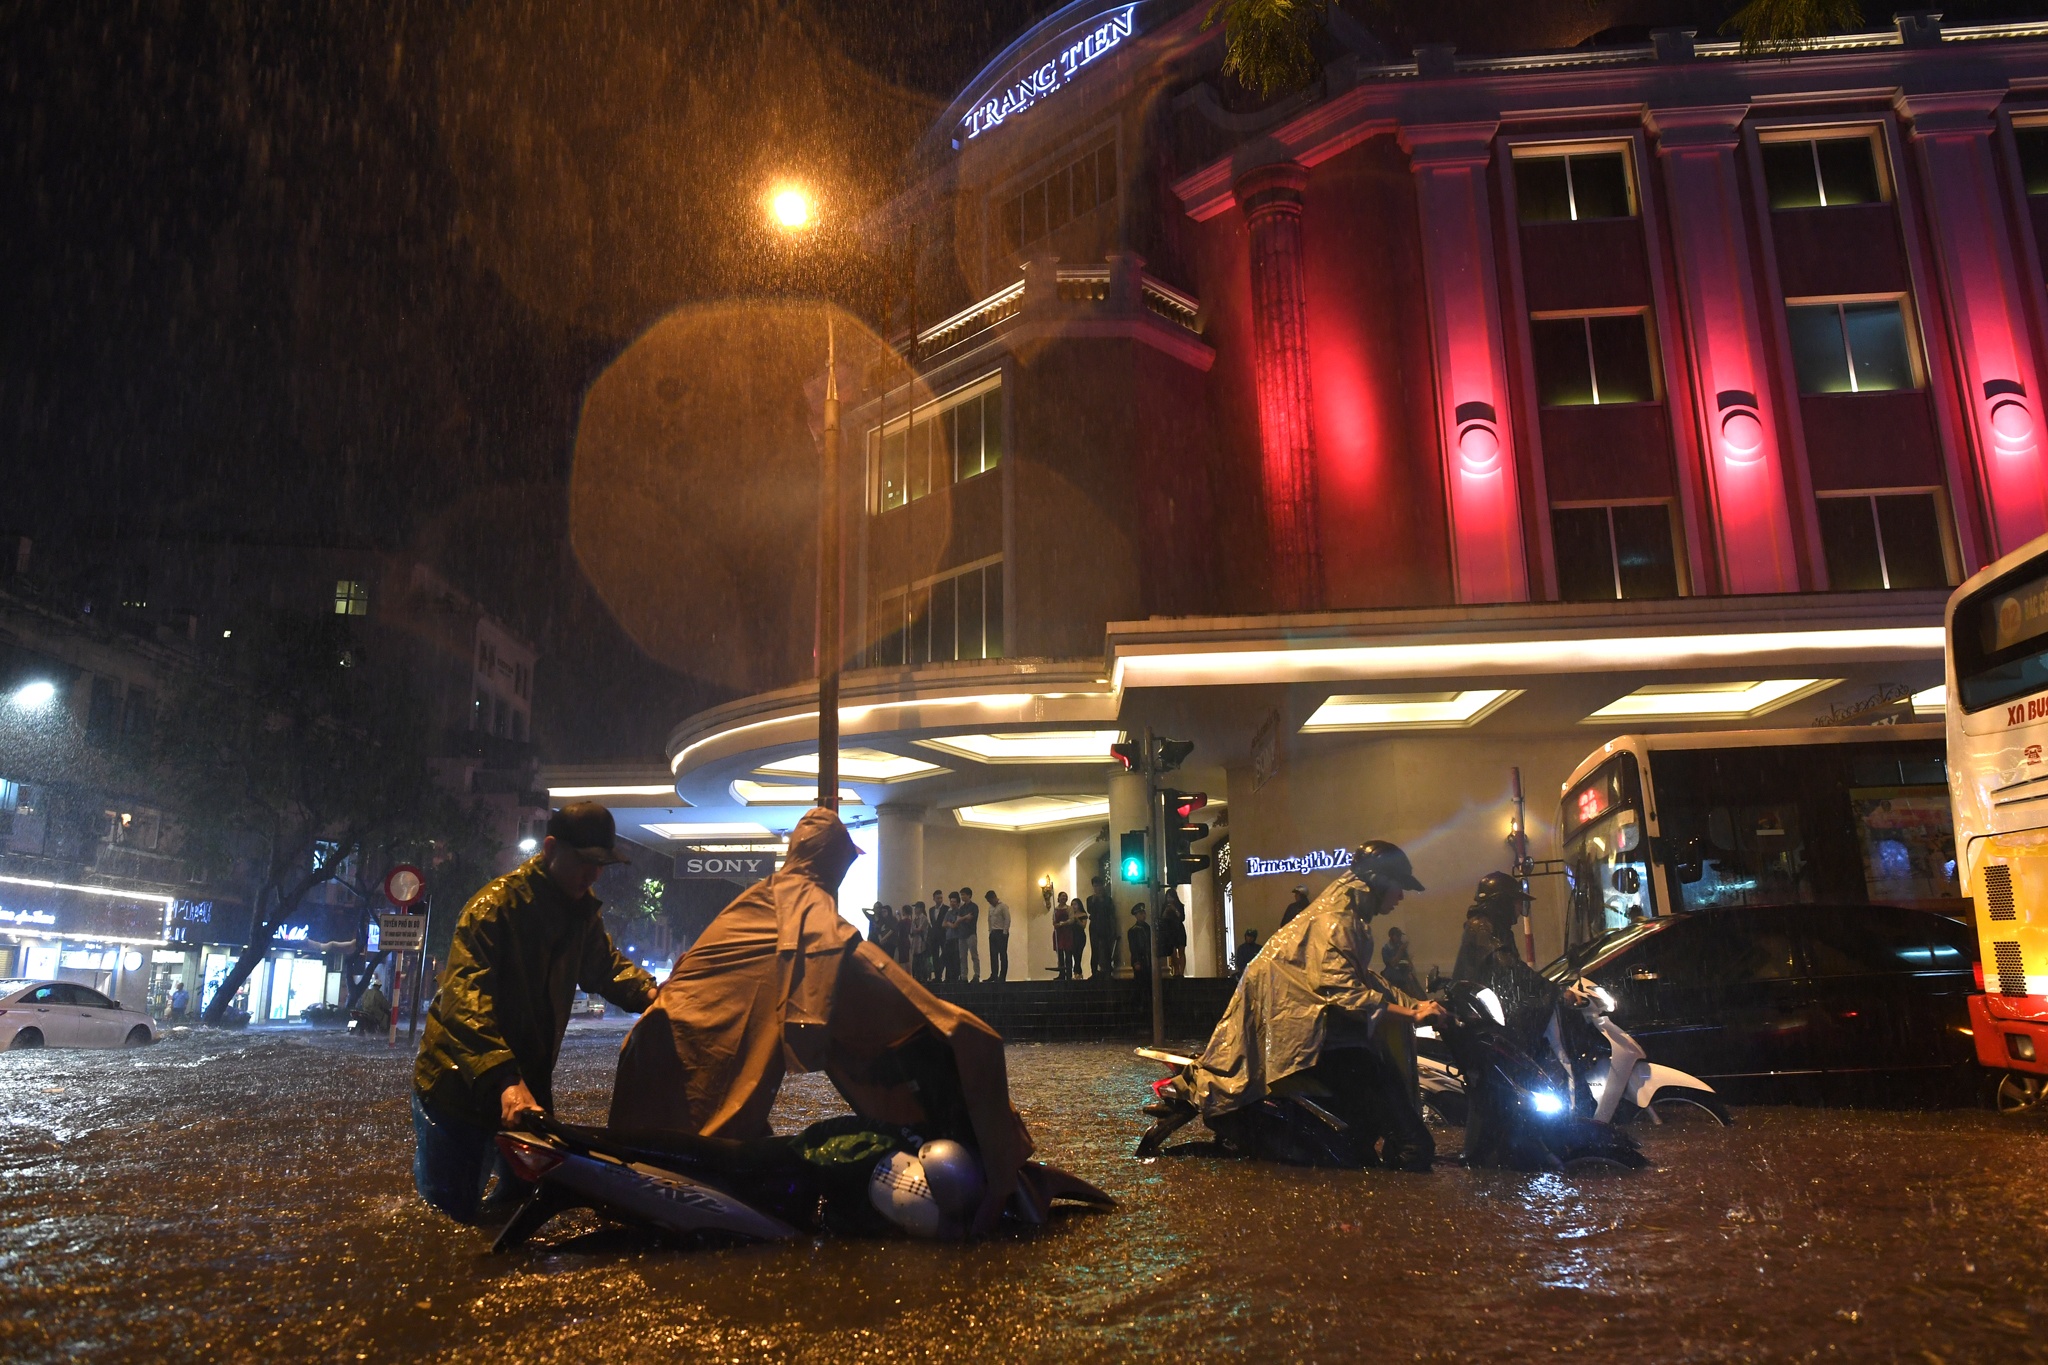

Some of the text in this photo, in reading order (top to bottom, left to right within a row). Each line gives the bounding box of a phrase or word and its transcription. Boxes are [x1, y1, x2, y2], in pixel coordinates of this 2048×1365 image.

[964, 6, 1135, 139] TRANG TIEN
[687, 858, 762, 873] SONY
[1246, 849, 1333, 876] Ermenegildo
